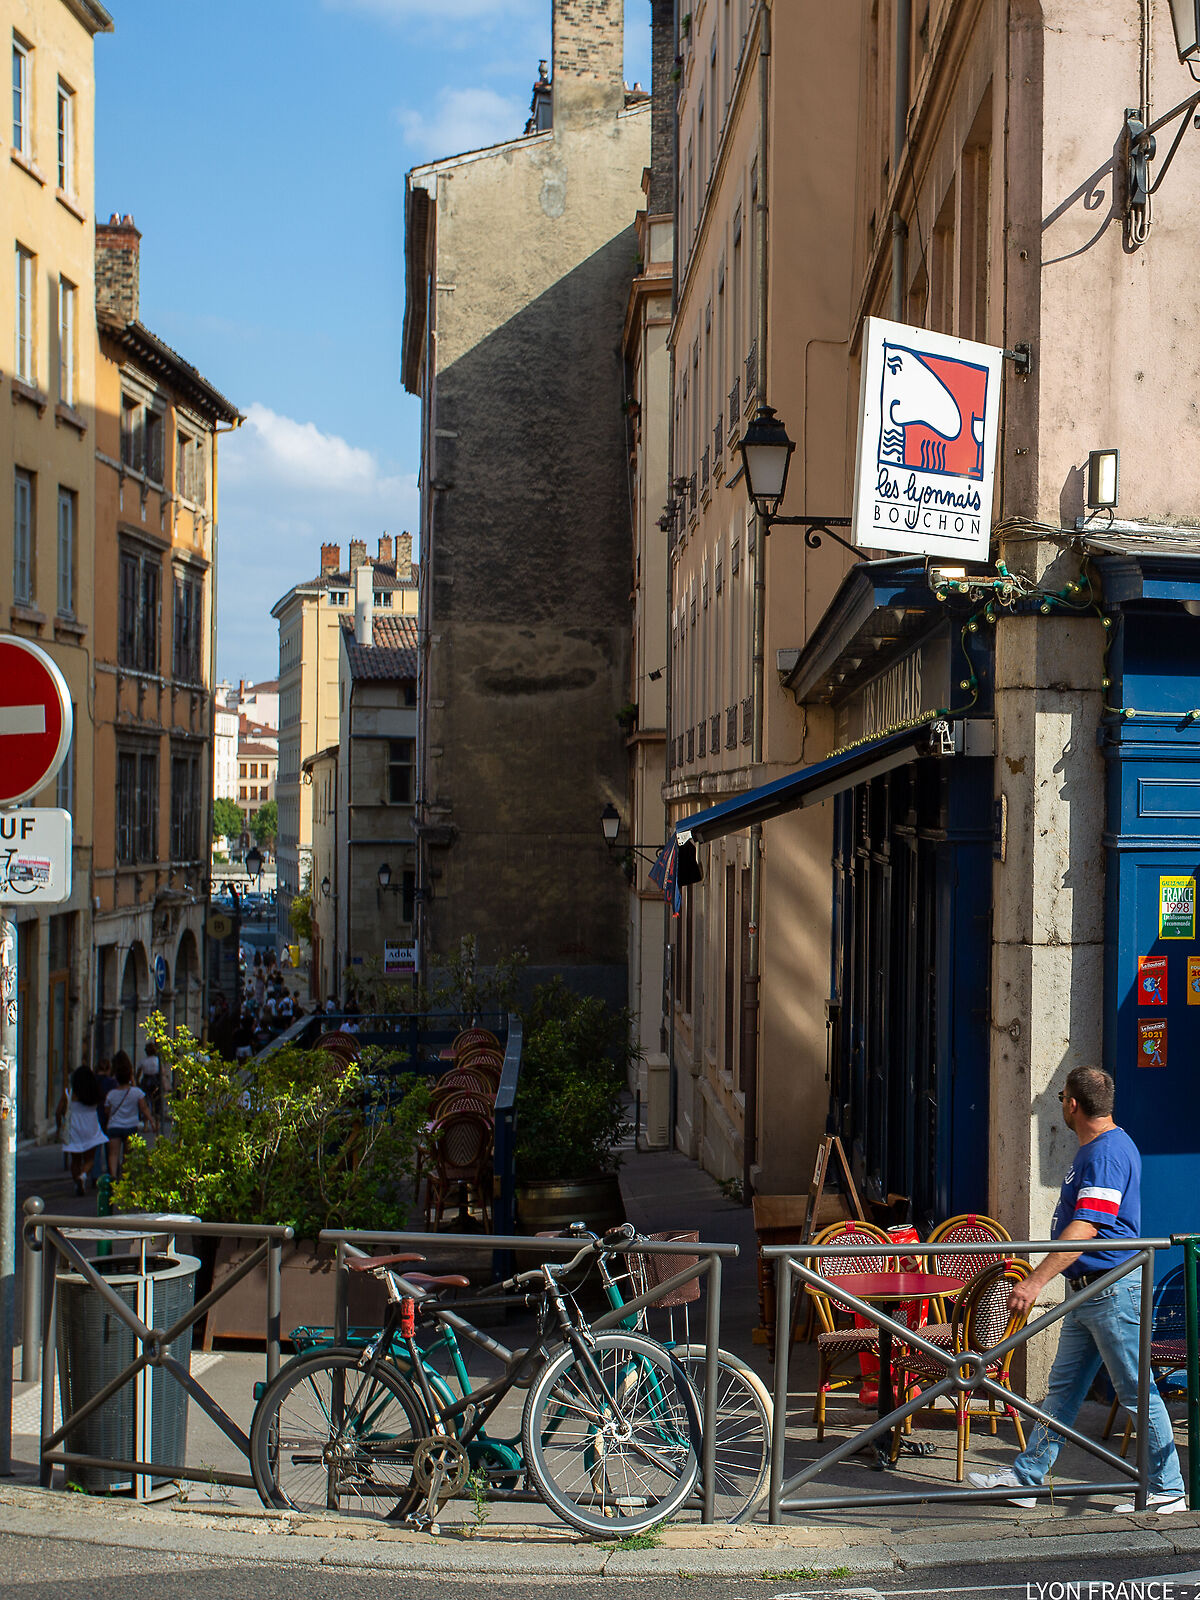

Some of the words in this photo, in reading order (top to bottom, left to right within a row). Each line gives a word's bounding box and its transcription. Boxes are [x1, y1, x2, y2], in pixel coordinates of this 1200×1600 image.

[875, 467, 899, 498] les
[903, 472, 981, 529] lyonnais
[874, 505, 981, 535] BOUCHON
[1162, 887, 1194, 902] FRANCE
[1166, 902, 1190, 913] 1998
